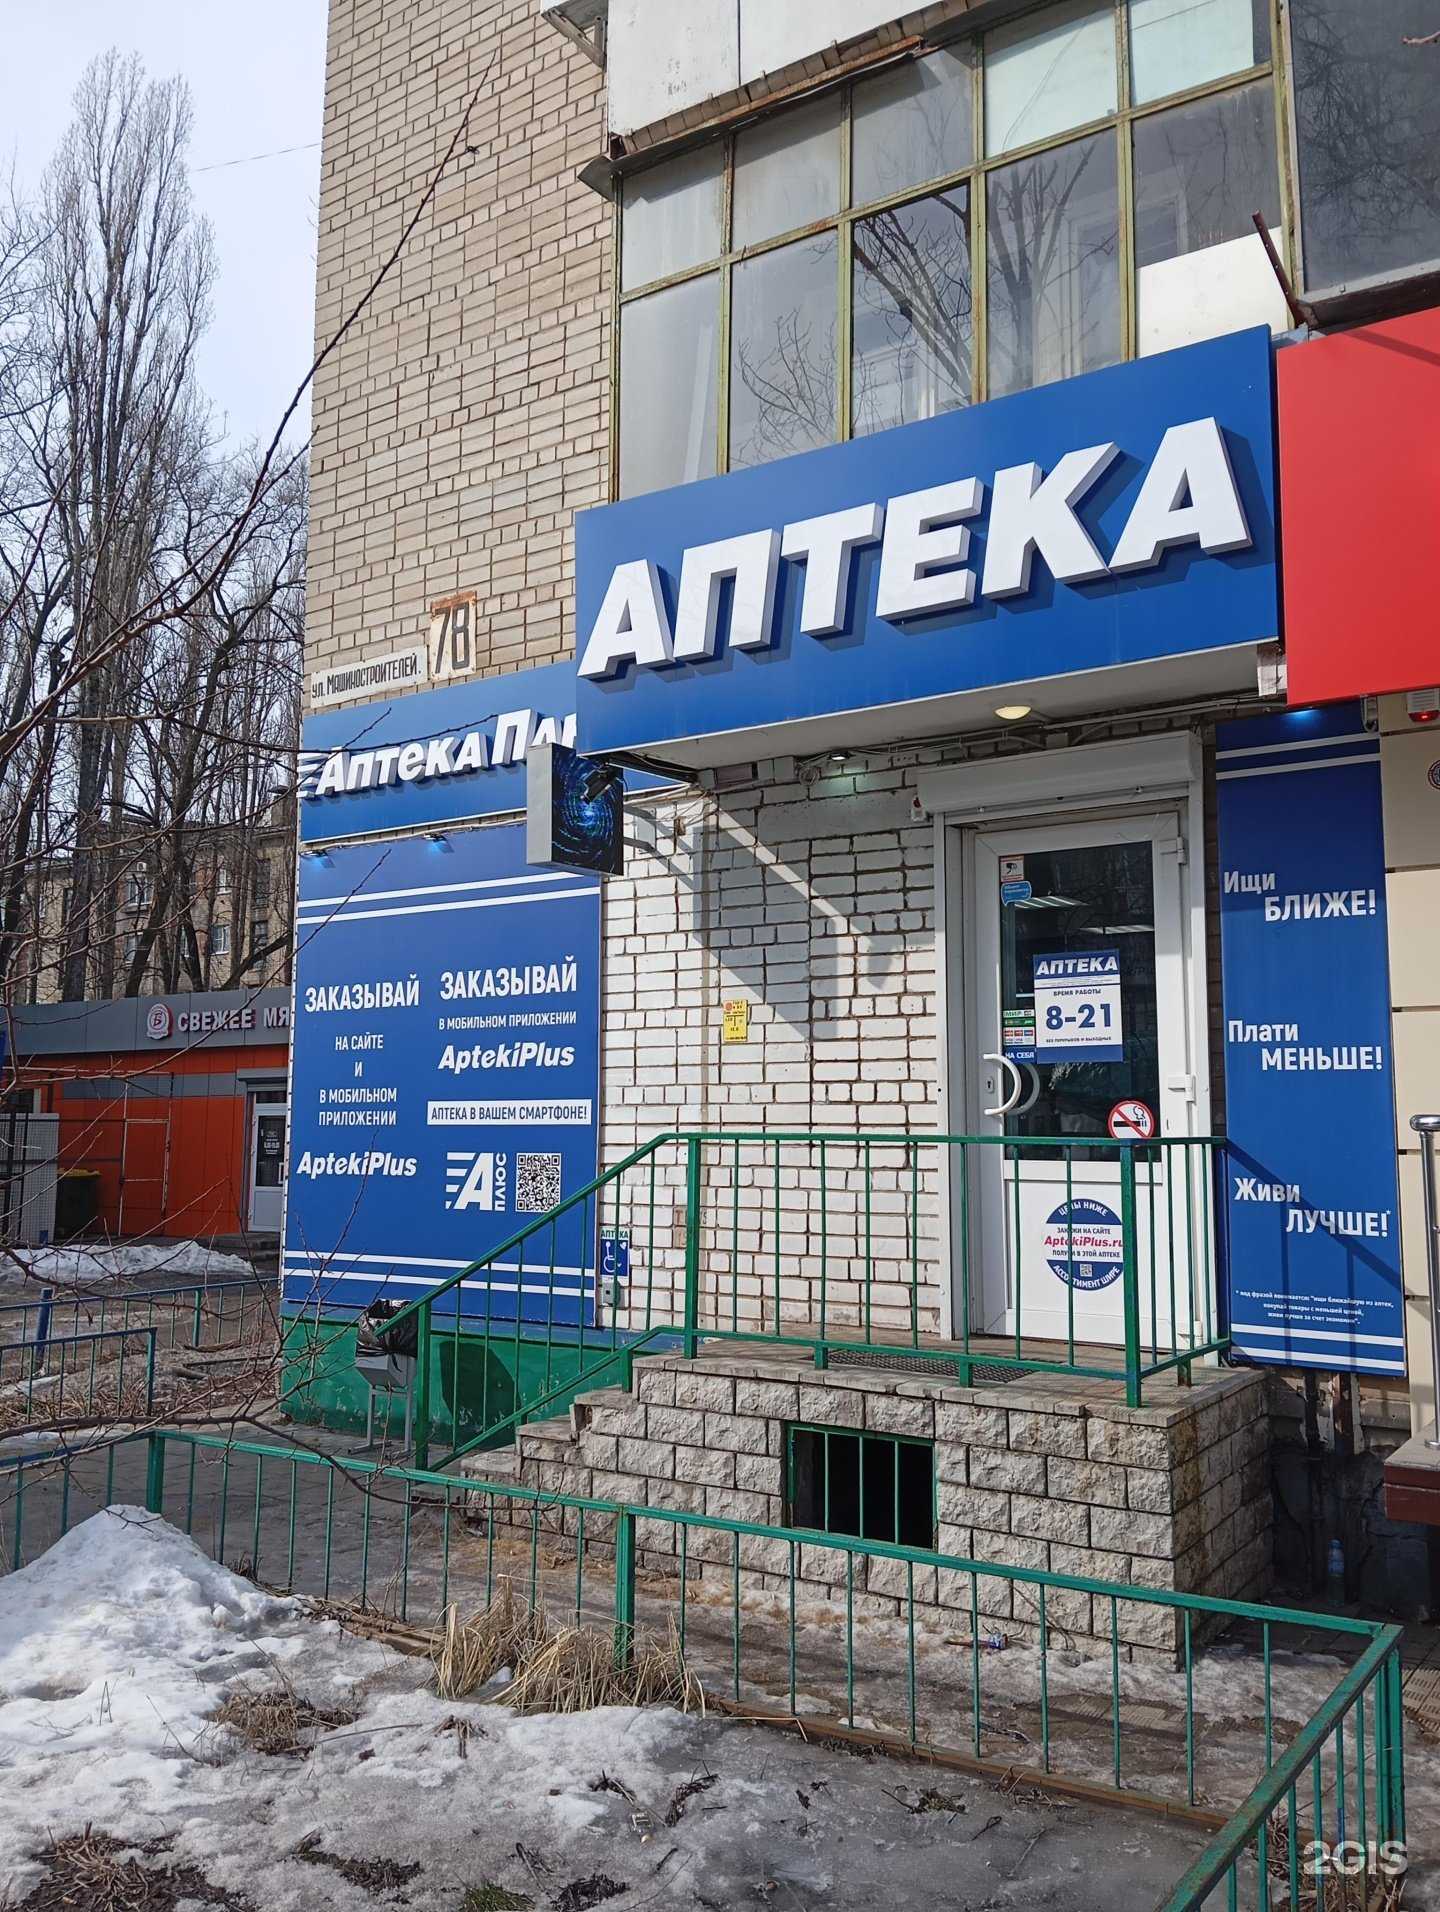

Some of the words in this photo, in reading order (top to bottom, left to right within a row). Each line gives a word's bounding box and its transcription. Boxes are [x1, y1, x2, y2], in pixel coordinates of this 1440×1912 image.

[576, 416, 1252, 682] АПТЕКА
[432, 601, 471, 678] 78
[1223, 871, 1276, 894] Ищи
[1264, 889, 1377, 922] БЛИЖЕ!
[440, 955, 578, 1000] ЗАКАЗЫВАЙ
[1036, 956, 1118, 976] АПТЕКА
[304, 973, 420, 1013] ЗАКАЗЫВАЙ
[178, 1009, 253, 1032] СВЕЖЕЕ
[439, 1018, 445, 1030] В
[447, 1014, 507, 1030] МОБИЛЬНОМ
[509, 1011, 577, 1028] ПРИЛОЖЕНИИ
[1045, 1003, 1111, 1030] 8-21
[335, 1036, 348, 1050] НА
[351, 1031, 384, 1050] САЙТЕ
[1228, 1020, 1299, 1043] Плати
[438, 1041, 575, 1074] AptekiPlus
[1261, 1046, 1383, 1071] МЕНЬШЕ!
[355, 1062, 363, 1077] И
[320, 1089, 326, 1104] В
[328, 1088, 397, 1104] МОБИЛЬНОМ
[319, 1110, 397, 1126] ПРИЛОЖЕНИИ
[431, 1106, 468, 1120] АПТЕКА
[470, 1107, 476, 1120] В
[478, 1106, 517, 1120] ВАШЕМ
[519, 1104, 587, 1121] СМАРТФОНЕ!
[296, 1151, 417, 1180] AptekiPlus
[495, 1152, 507, 1211] ПЛЮС
[1234, 1177, 1300, 1203] Живи
[1084, 1201, 1109, 1216] НИЖЕ
[601, 1230, 629, 1238] АПТКА
[1092, 1227, 1111, 1235] САЙТЕ
[1053, 1264, 1101, 1288] АССОТИМЕНТ
[1101, 1265, 1120, 1285] ШИРЕ
